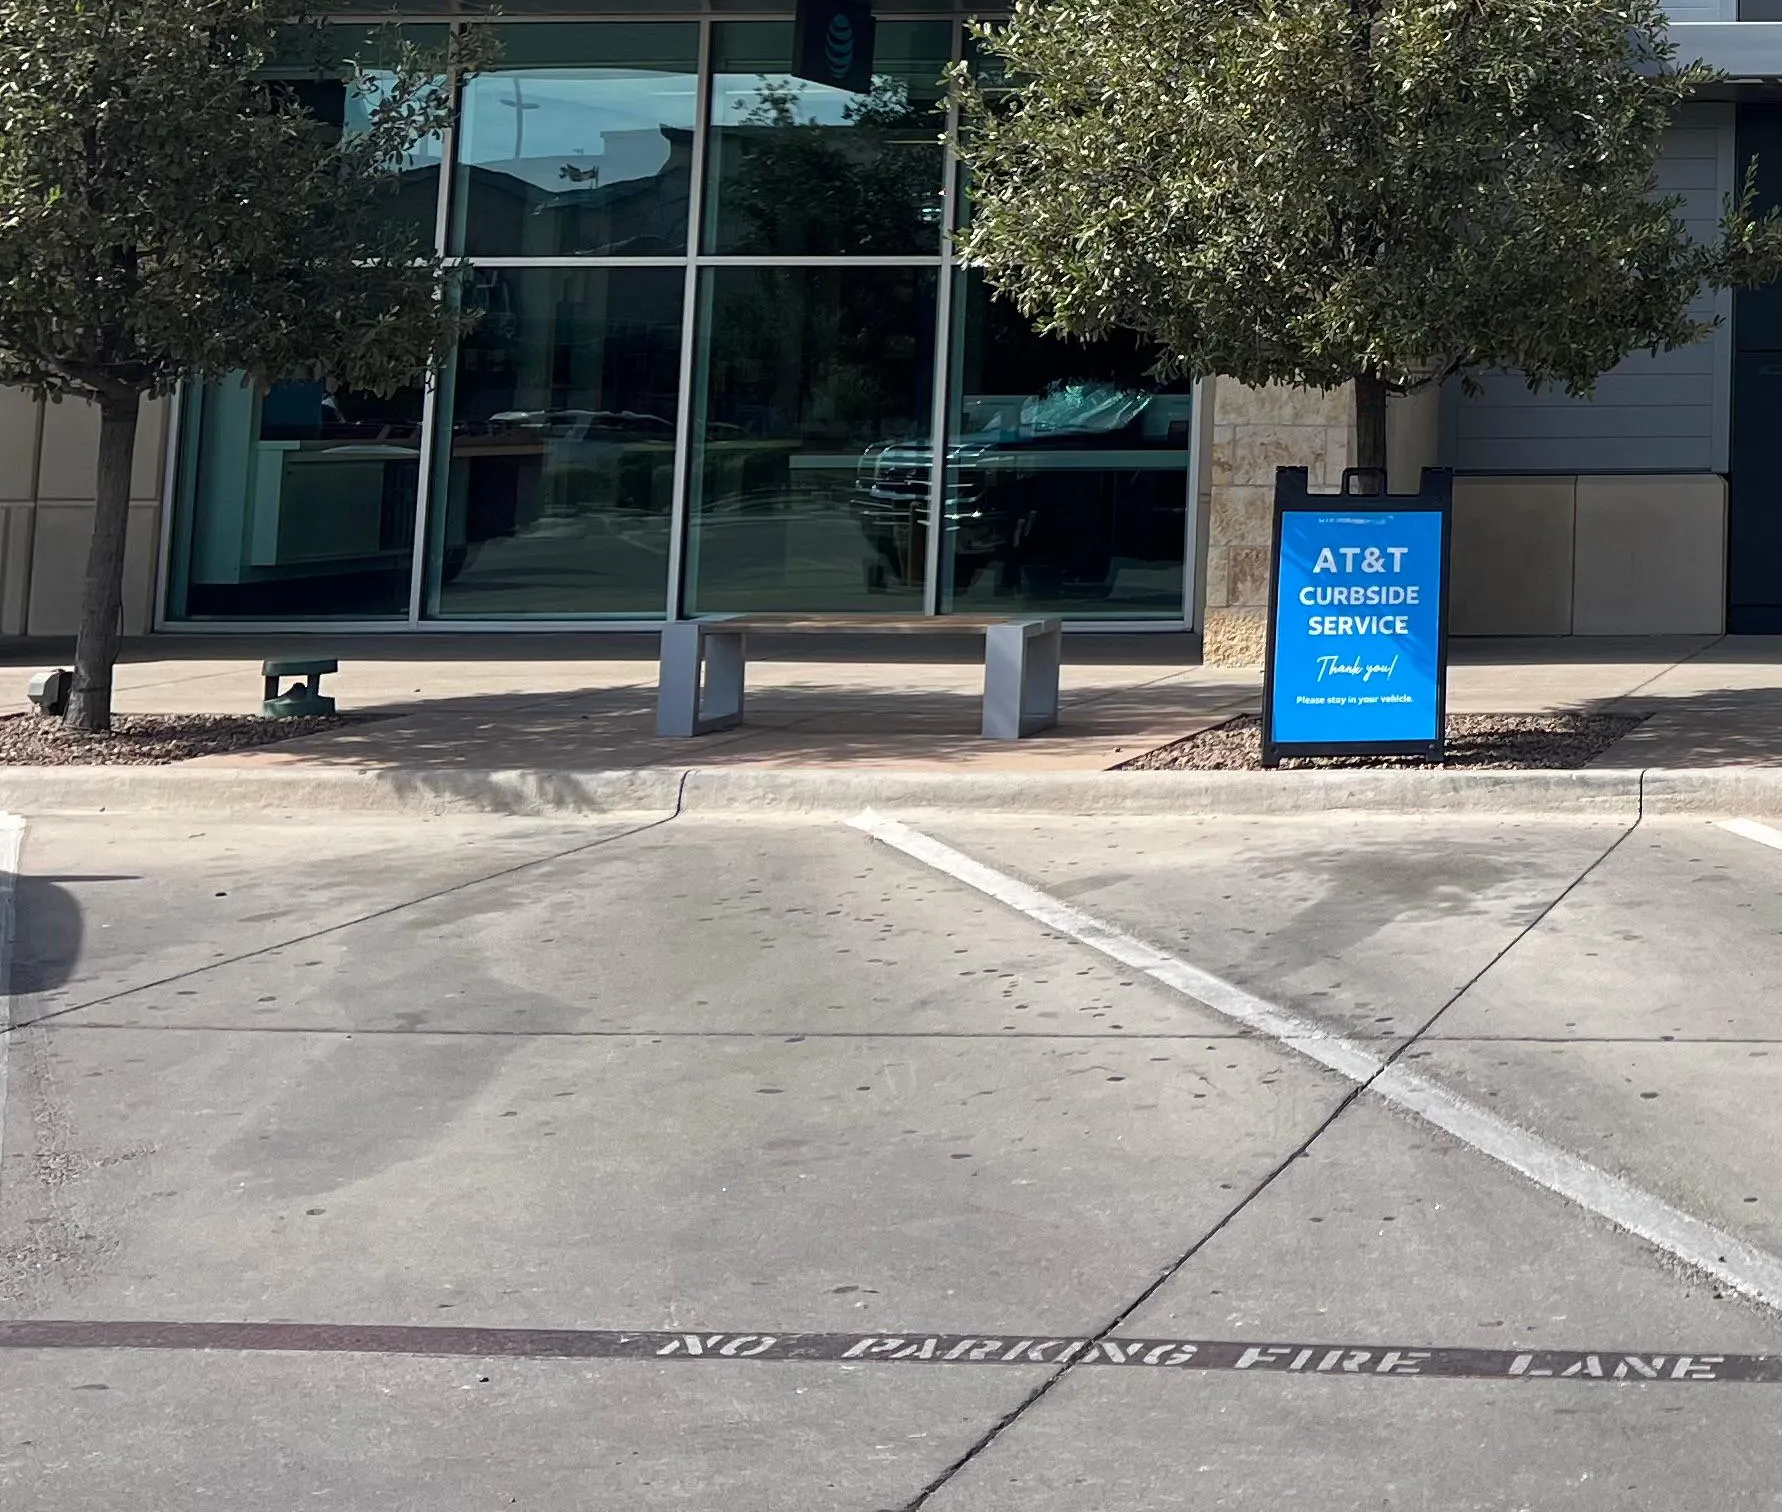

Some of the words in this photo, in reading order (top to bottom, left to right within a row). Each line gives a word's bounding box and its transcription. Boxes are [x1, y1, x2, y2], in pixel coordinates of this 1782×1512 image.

[1313, 546, 1408, 573] AT&T
[1299, 586, 1419, 605] CURBSIDE
[1308, 615, 1409, 635] SERVICE
[1316, 655, 1362, 682] Thank
[1365, 654, 1398, 682] you!
[1296, 695, 1325, 704] Please
[1327, 696, 1347, 706] stay
[1348, 695, 1357, 704] in
[1358, 697, 1378, 705] your
[1380, 695, 1413, 704] vehicle.
[656, 1335, 777, 1356] NO
[841, 1338, 1198, 1365] PARKING
[1234, 1348, 1432, 1373] FIRE
[1507, 1354, 1725, 1379] LANE
